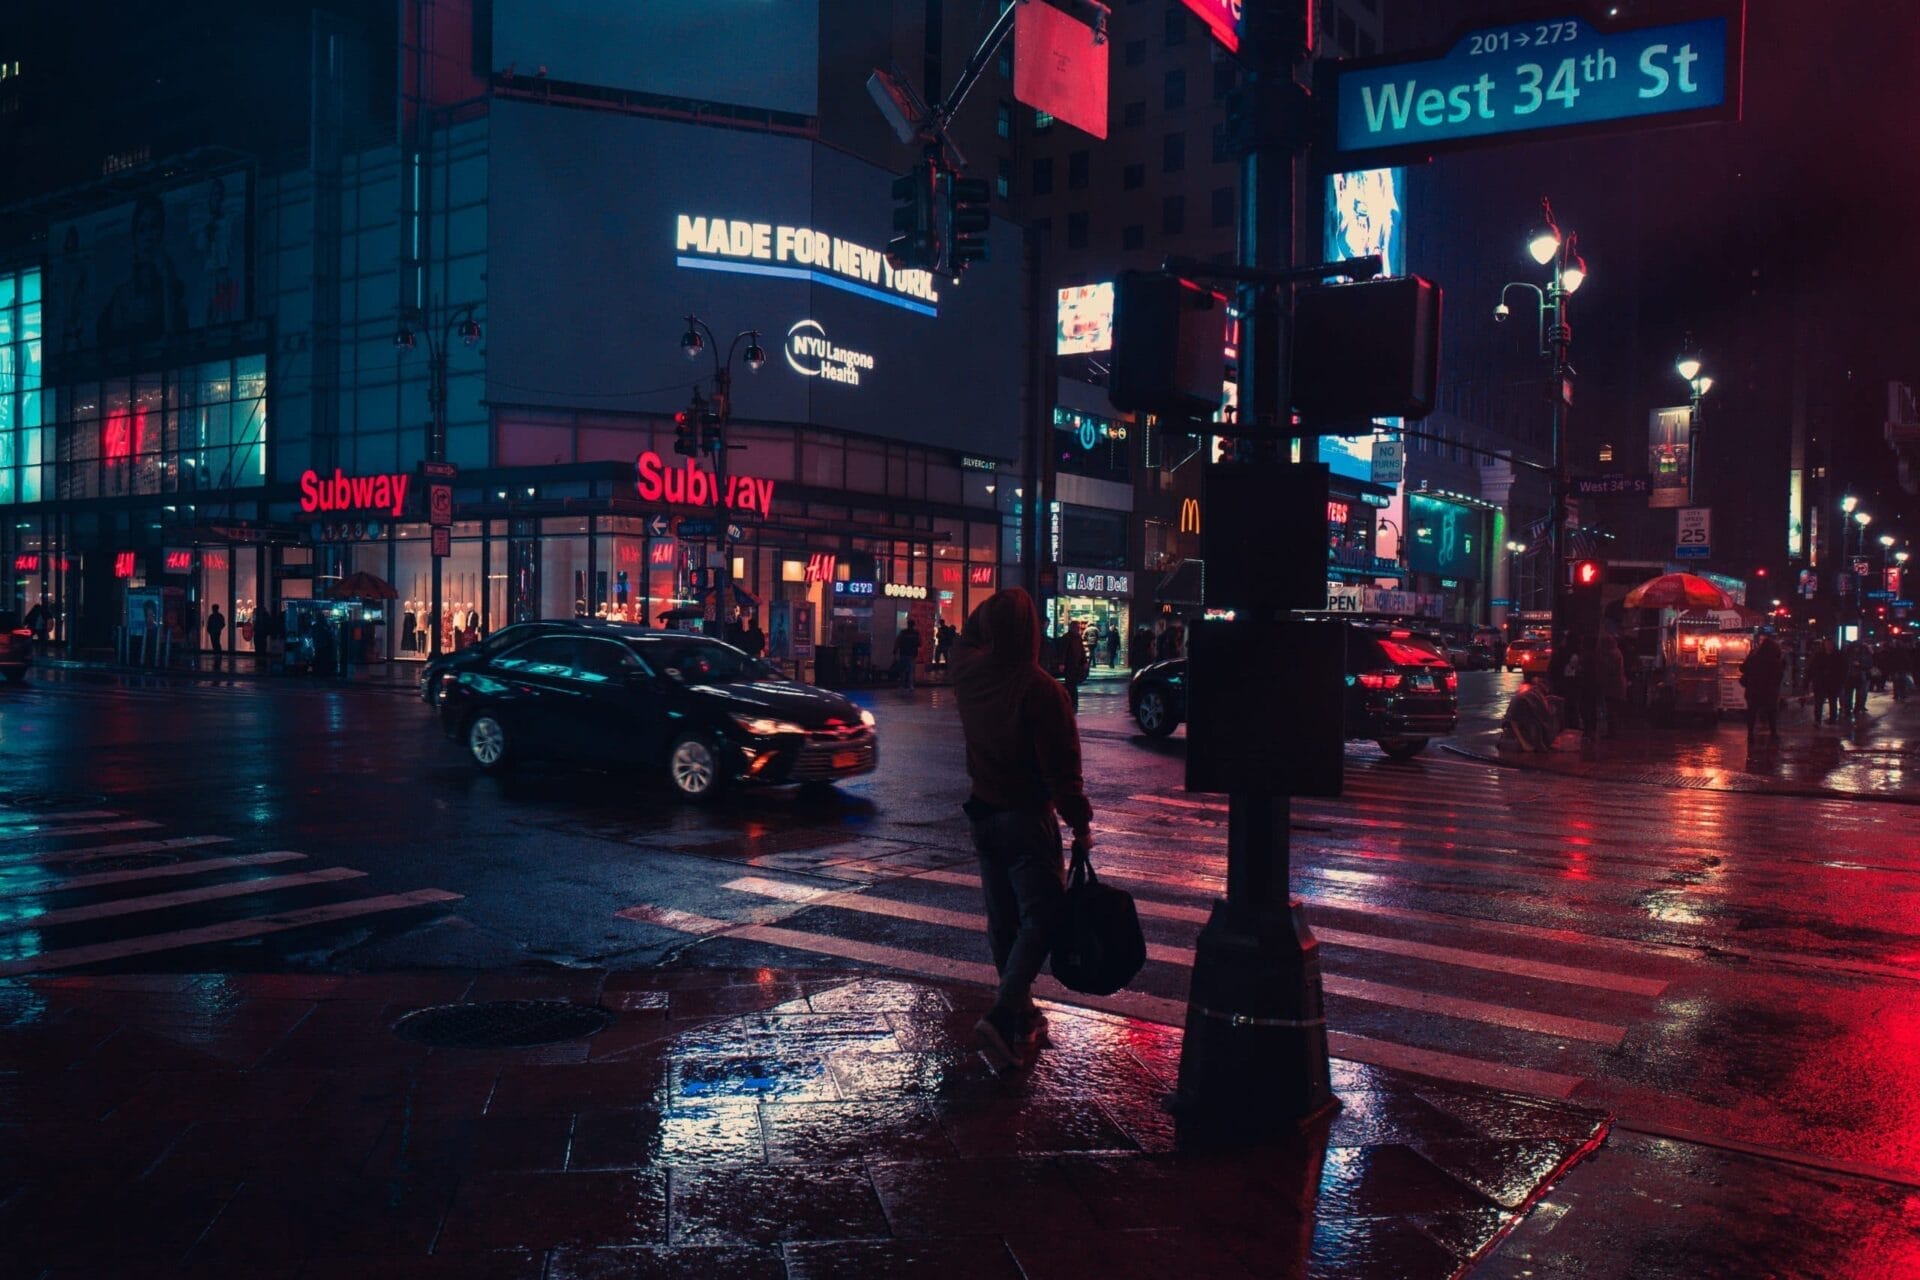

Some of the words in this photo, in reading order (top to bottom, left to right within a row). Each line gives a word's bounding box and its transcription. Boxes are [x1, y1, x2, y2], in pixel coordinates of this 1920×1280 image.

[1470, 32, 1510, 56] 201
[1535, 21, 1578, 46] 273
[1361, 73, 1496, 133] West
[1513, 48, 1617, 116] 34th
[1638, 43, 1699, 99] St
[677, 214, 772, 260] MADE
[776, 226, 831, 269] FOR
[833, 237, 883, 284] NEW
[794, 336, 826, 359] NYU
[827, 341, 874, 370] Langone
[821, 361, 860, 386] Health
[1375, 461, 1401, 470] TURNS
[1380, 447, 1395, 457] NO
[301, 467, 409, 518] Subway
[1581, 481, 1607, 492] West
[1634, 480, 1646, 491] St
[1681, 528, 1706, 543] 25
[804, 552, 836, 584] H&M
[1078, 573, 1104, 591] A&H
[1107, 576, 1128, 592] Deli
